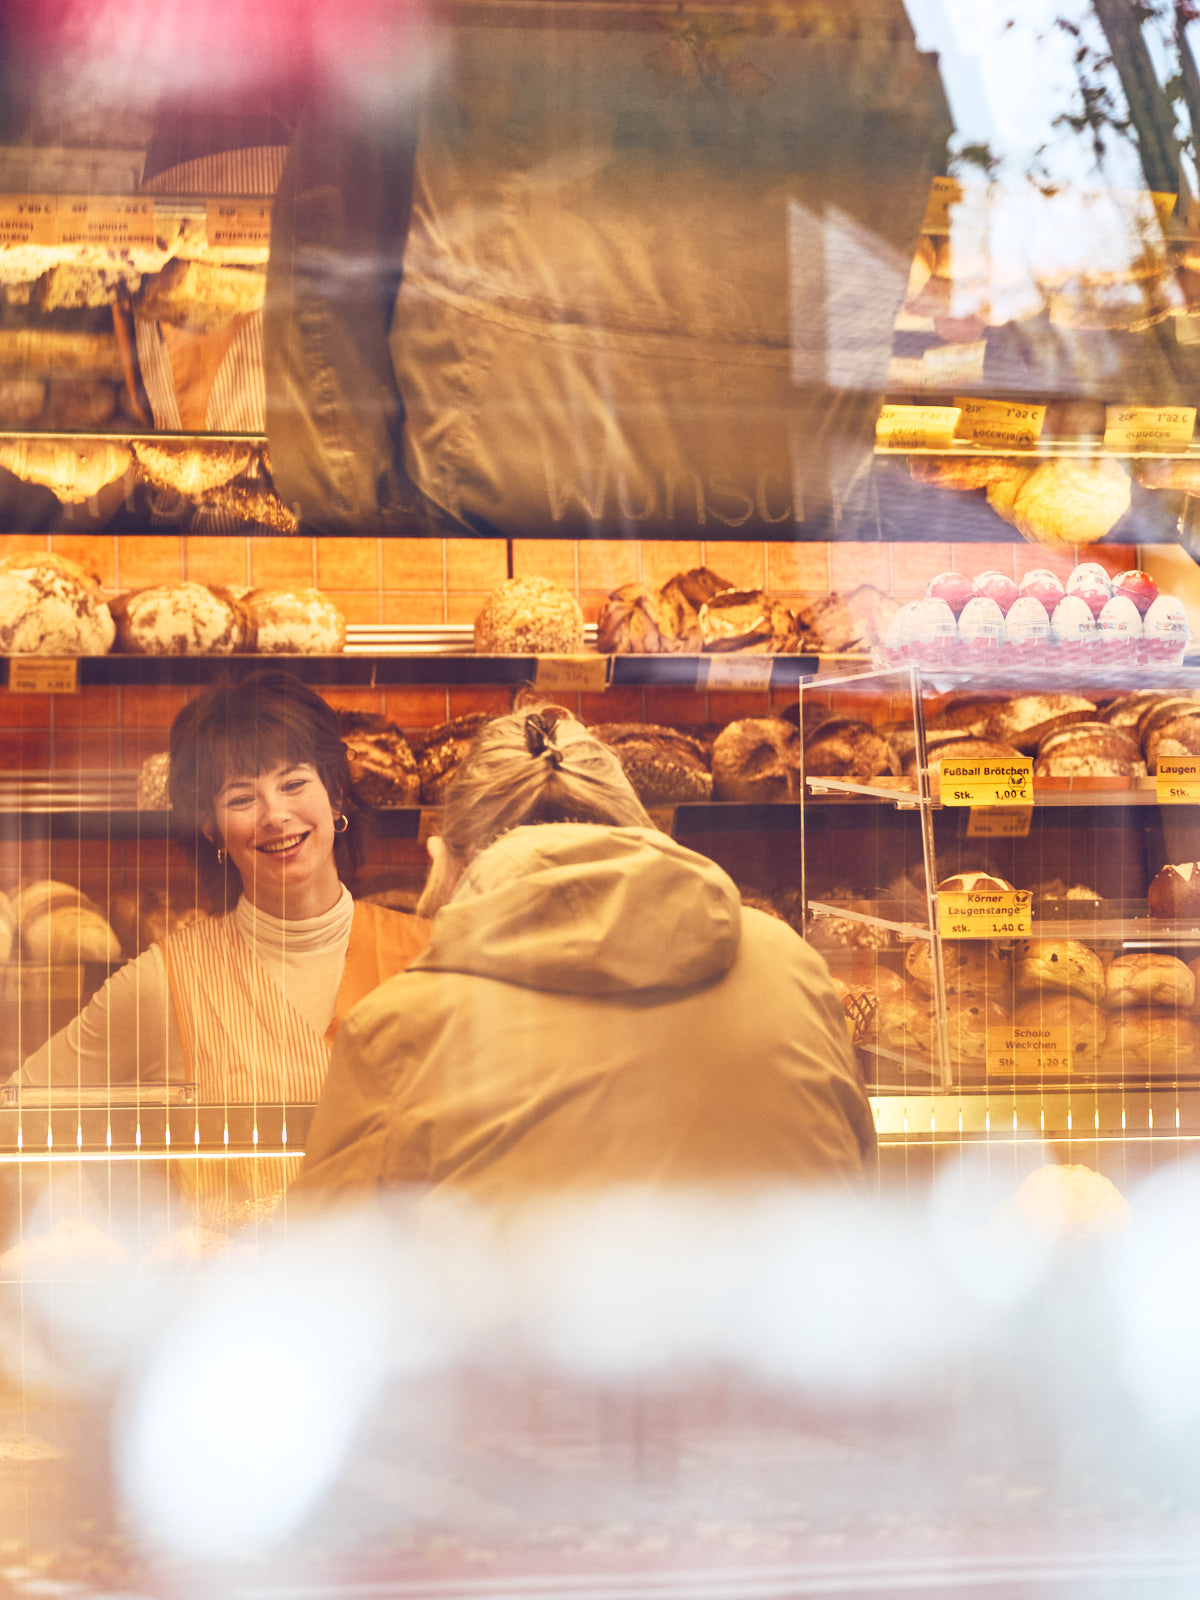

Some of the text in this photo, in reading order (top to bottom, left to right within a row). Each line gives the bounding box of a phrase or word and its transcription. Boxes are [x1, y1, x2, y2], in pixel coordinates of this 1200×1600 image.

[943, 766, 1029, 776] Fußball Brötchen
[1160, 765, 1196, 776] Laugen
[954, 791, 974, 800] Stk.
[995, 790, 1017, 800] 1,00
[1170, 788, 1190, 797] Stk.
[968, 894, 1003, 903] Körner
[948, 906, 1020, 916] Laugenstange
[951, 924, 971, 933] stk.
[992, 923, 1014, 933] 1,40
[1014, 1029, 1051, 1038] Schoko
[1005, 1040, 1057, 1049] Weckchen
[999, 1058, 1019, 1067] Stk.
[1037, 1058, 1059, 1067] 1,20
